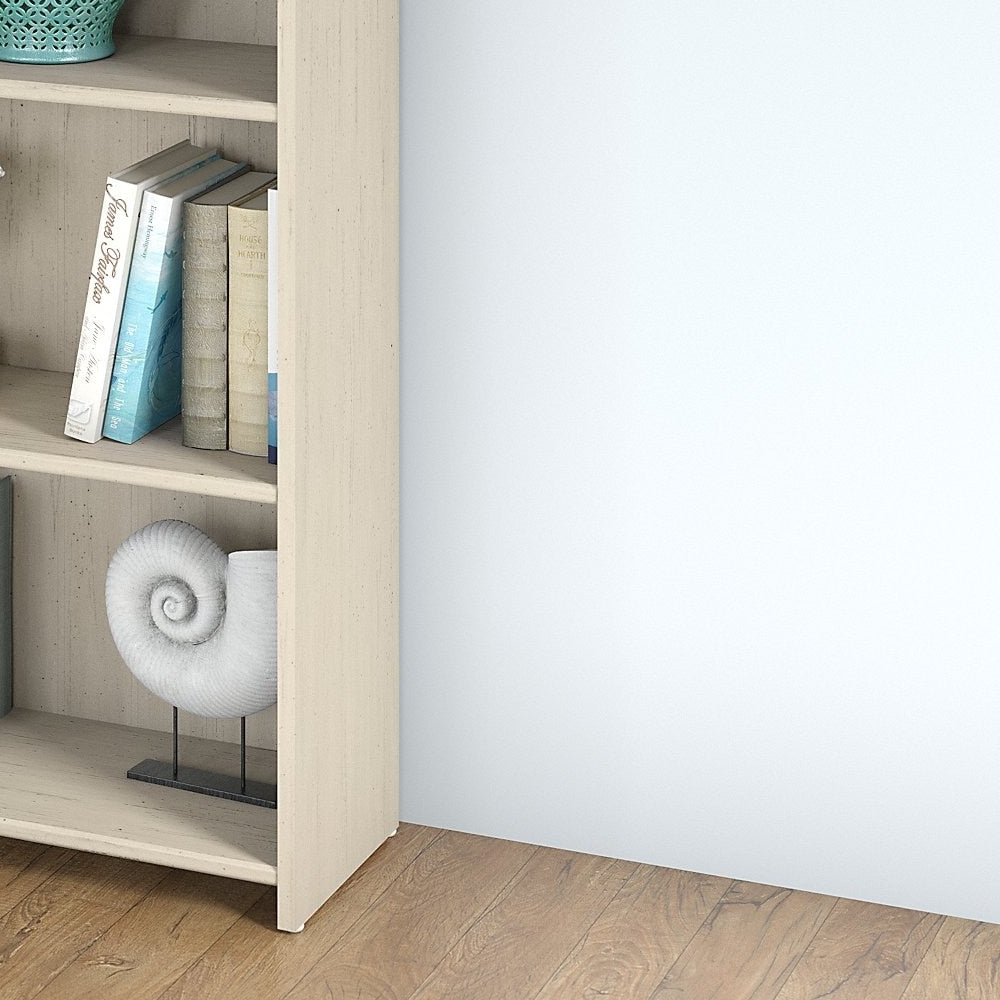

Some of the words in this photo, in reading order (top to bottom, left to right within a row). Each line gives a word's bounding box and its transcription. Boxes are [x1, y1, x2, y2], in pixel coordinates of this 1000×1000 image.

[104, 183, 128, 241] James
[147, 205, 157, 224] Ernest
[141, 224, 154, 259] Hemingway
[91, 241, 121, 304] Fairfax
